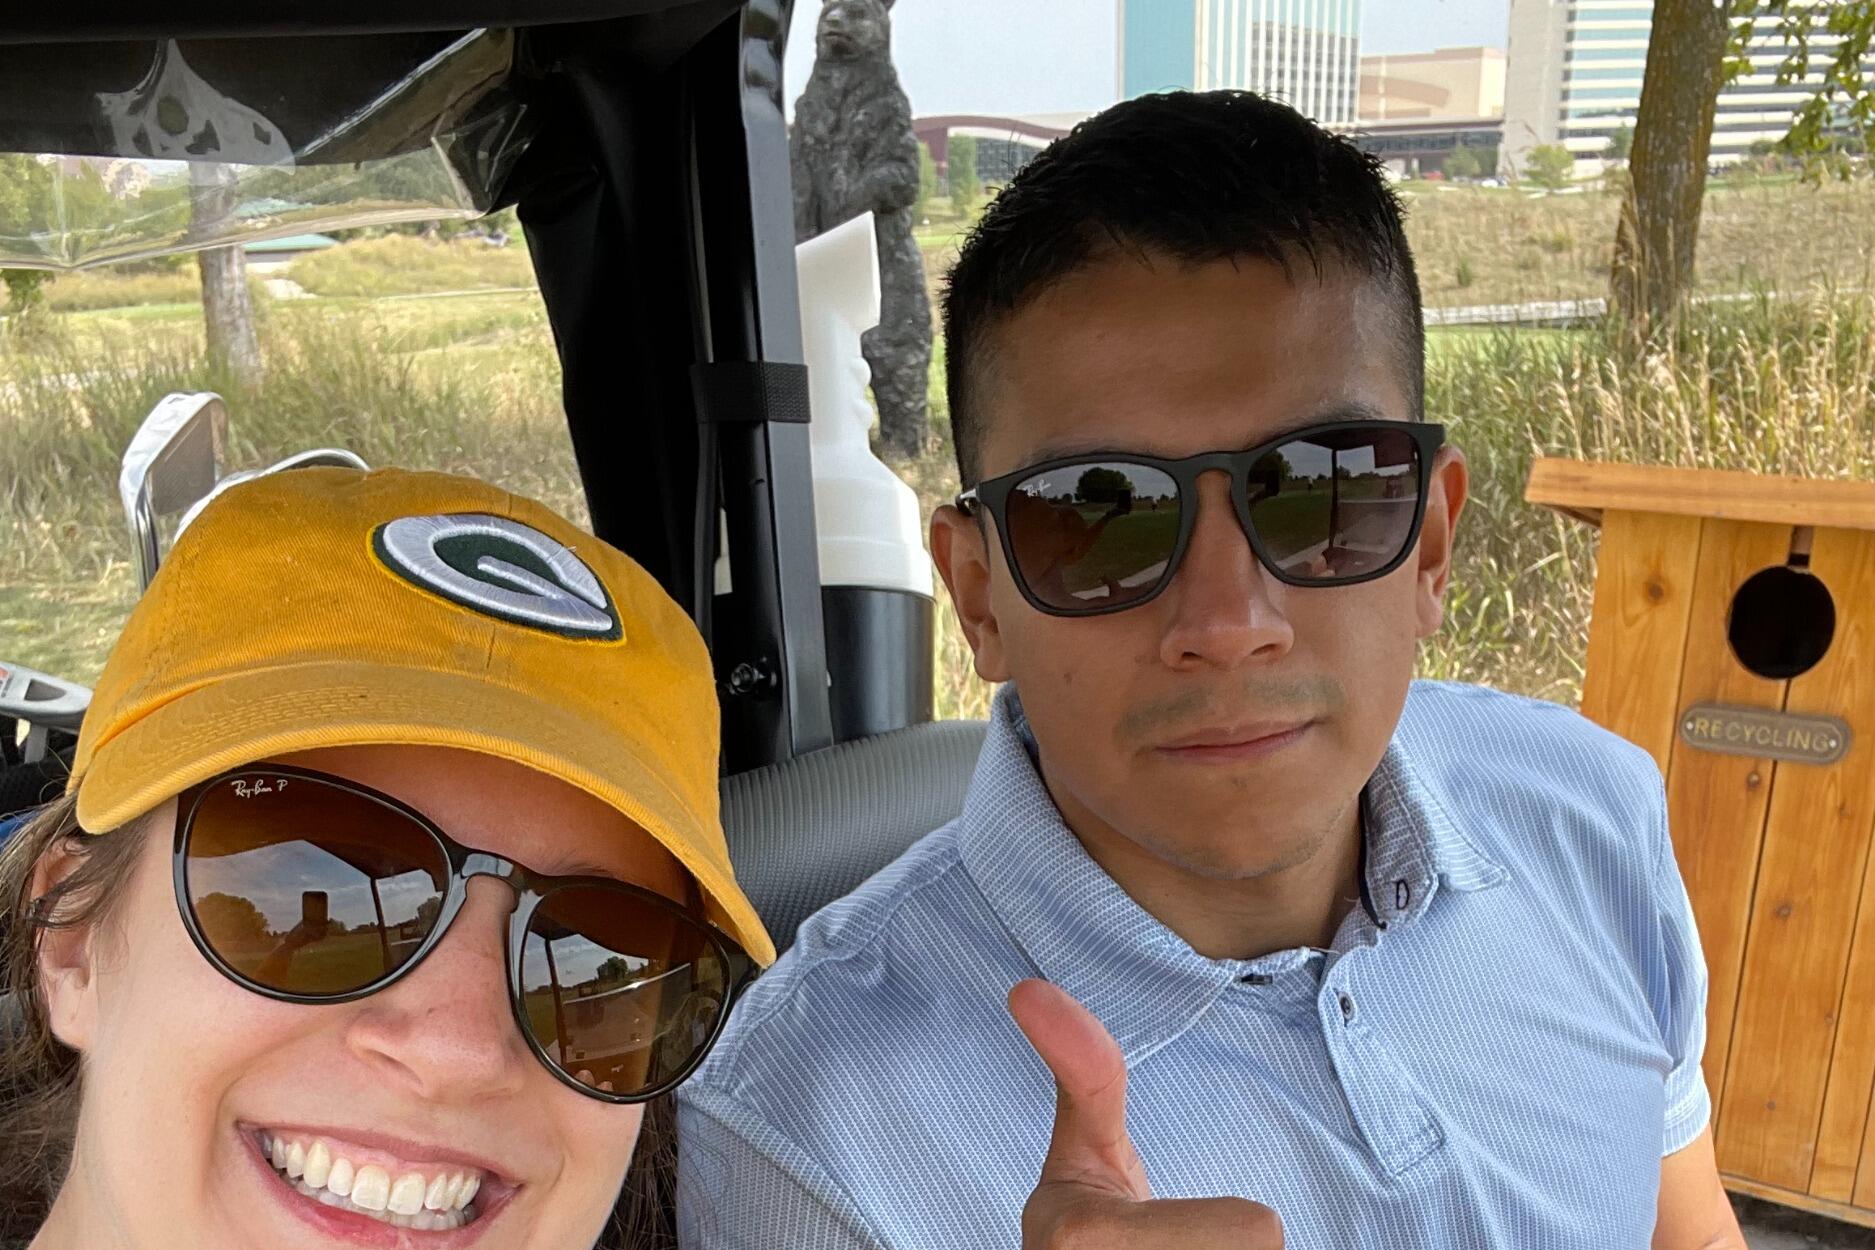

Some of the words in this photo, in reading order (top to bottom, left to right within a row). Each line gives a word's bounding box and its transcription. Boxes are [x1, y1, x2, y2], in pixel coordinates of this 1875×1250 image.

[383, 513, 613, 632] G
[1694, 717, 1830, 752] RECYCLING
[230, 779, 273, 799] Ray-Ban
[276, 779, 289, 793] P
